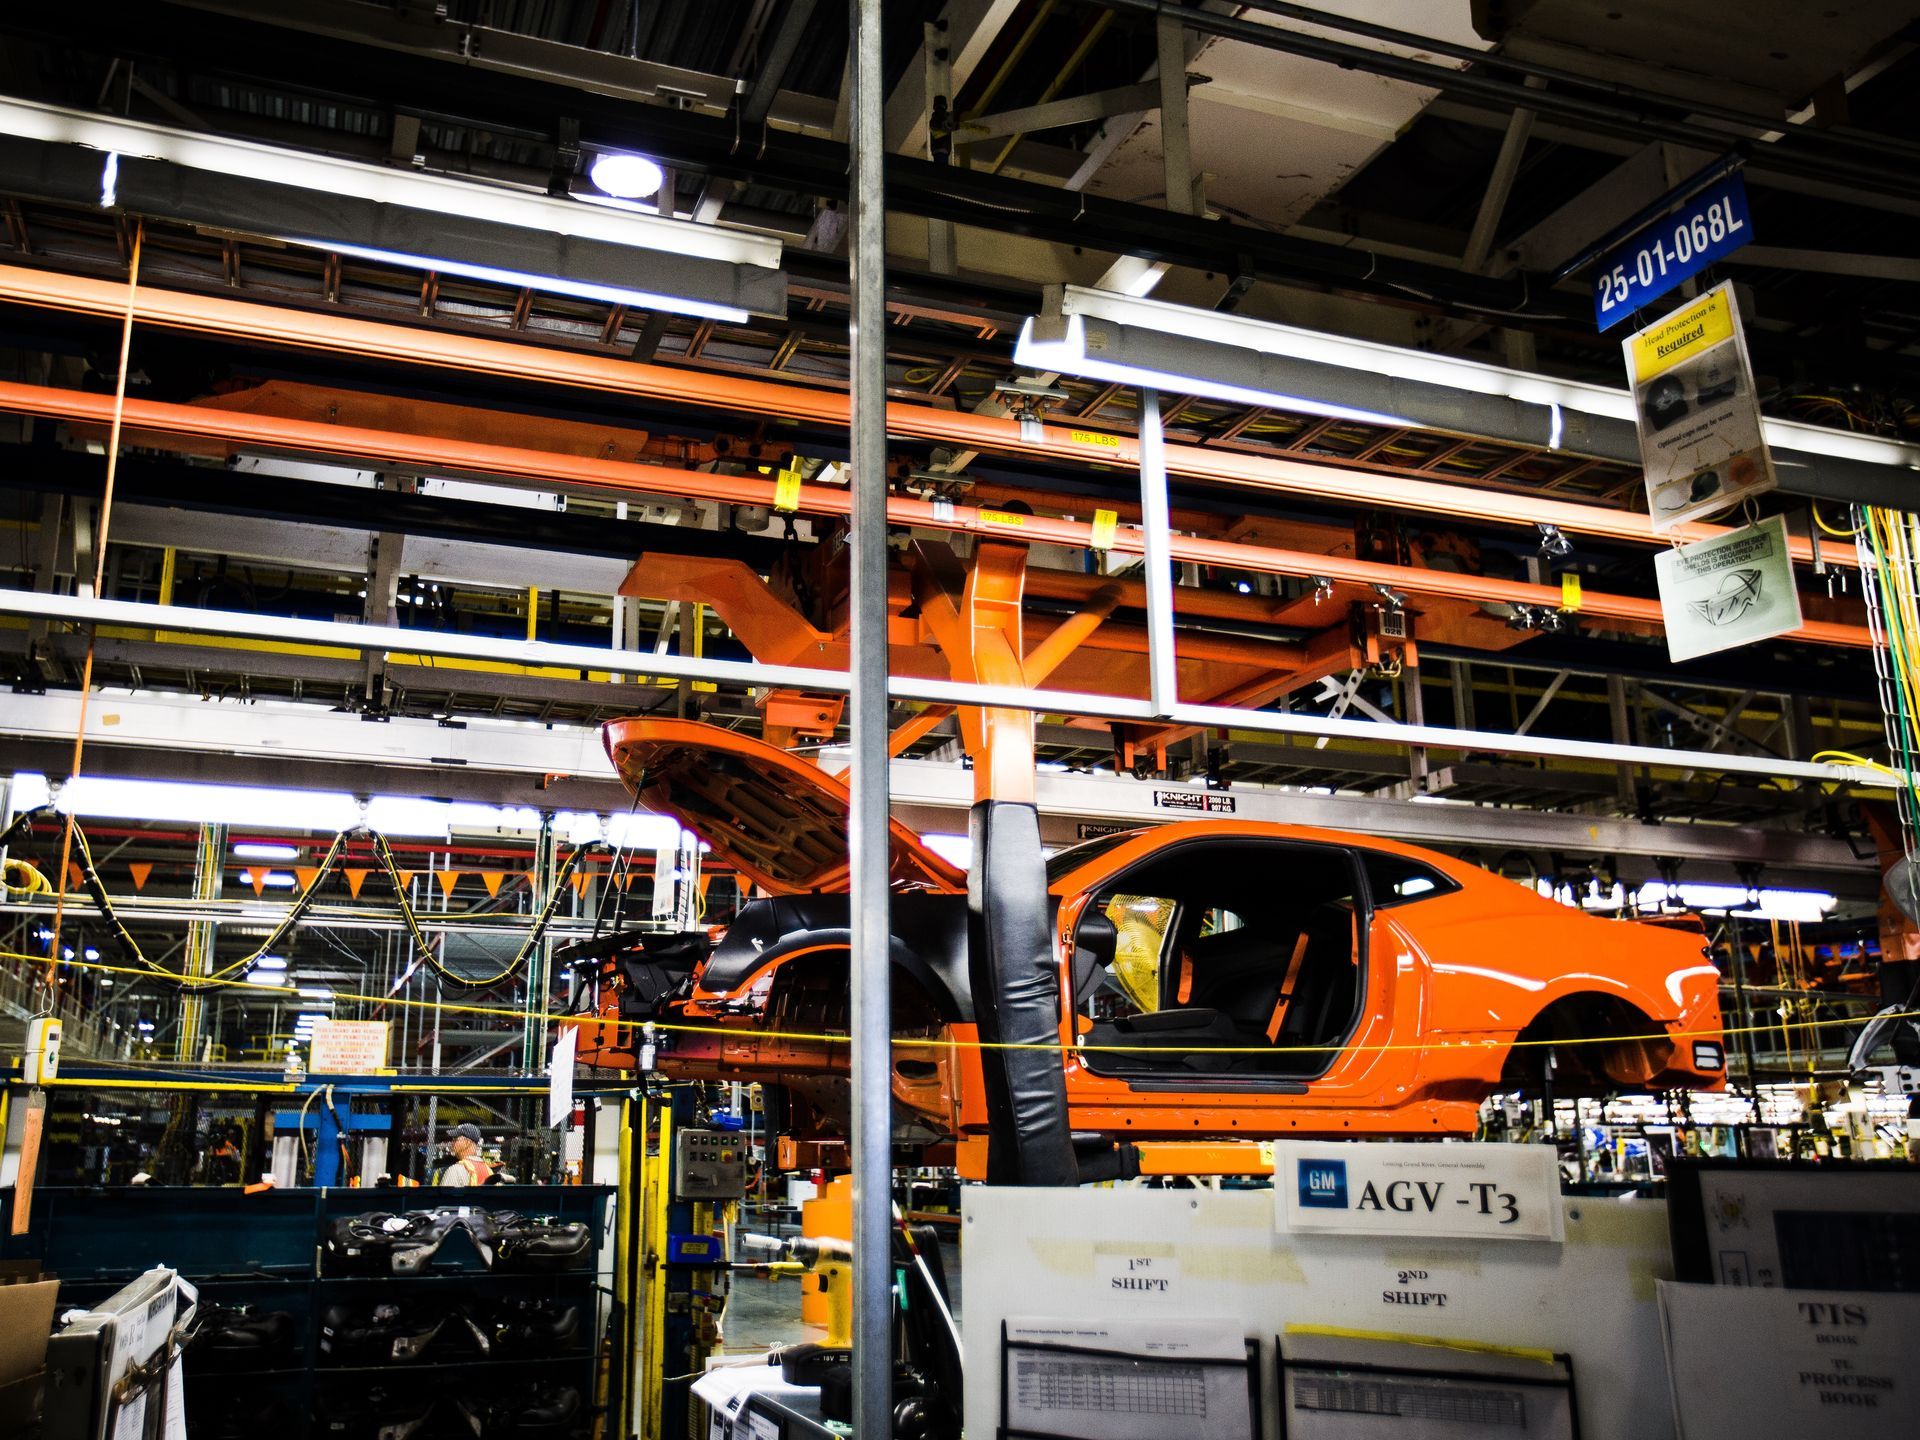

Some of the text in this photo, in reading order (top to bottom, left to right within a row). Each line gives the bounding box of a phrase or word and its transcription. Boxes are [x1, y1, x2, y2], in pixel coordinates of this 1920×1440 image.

[1598, 195, 1743, 313] 25-01-068L
[1644, 303, 1716, 347] Head Protection is
[1657, 323, 1704, 356] Required
[1074, 432, 1117, 447] 175 LBS
[983, 512, 1022, 526] 175 LBS
[1677, 556, 1690, 567] EYE
[1690, 545, 1732, 563] PROTECTION
[1733, 540, 1750, 550] WITH
[1719, 545, 1753, 560] REQUIRED
[1754, 542, 1764, 550] AT
[1696, 554, 1752, 574] THIS OPERATION
[1163, 792, 1201, 802] KNIGHT
[1086, 825, 1122, 833] KNIGHT
[1309, 1170, 1335, 1190] GM
[1356, 1180, 1519, 1224] AGV -T3
[1128, 1258, 1152, 1271] 1ST
[1111, 1277, 1168, 1291] SHIFT
[1397, 1270, 1428, 1284] 2ND
[1382, 1290, 1447, 1306] SHIFT
[1798, 1302, 1868, 1327] TIS
[1815, 1333, 1858, 1345] BOOK
[1798, 1371, 1893, 1389] PROCESS
[1819, 1390, 1879, 1408] BOOK
